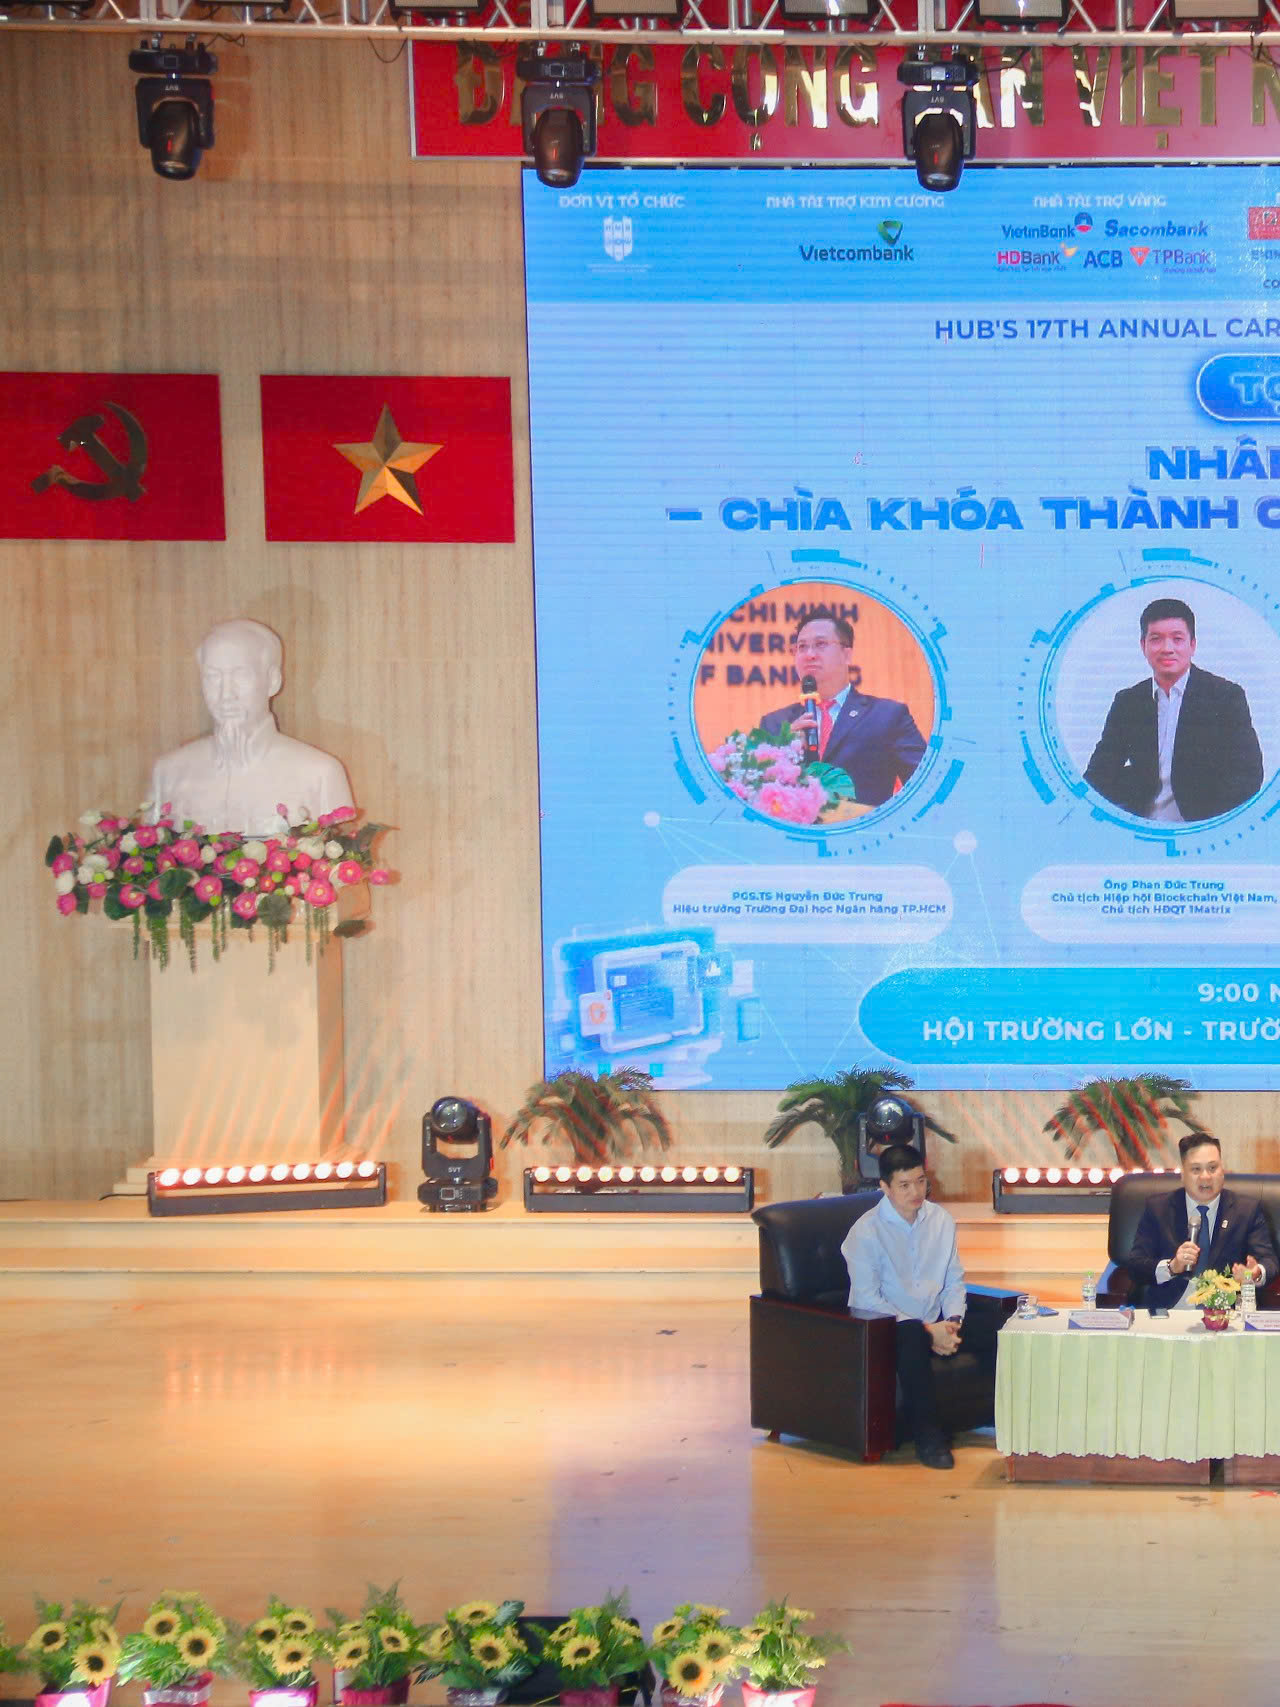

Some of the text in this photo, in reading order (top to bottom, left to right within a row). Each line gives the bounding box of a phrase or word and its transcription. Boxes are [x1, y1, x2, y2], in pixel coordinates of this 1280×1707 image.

[1001, 224, 1076, 239] VietinBank
[1104, 219, 1208, 237] Sacombank
[799, 245, 914, 261] Vietcombank
[997, 250, 1060, 265] HDBank
[1083, 250, 1123, 269] ACB
[1152, 249, 1211, 265] TPBank
[935, 319, 1018, 339] HUB'S
[1027, 319, 1089, 339] 17TH
[1099, 318, 1217, 338] ANNUAL
[719, 486, 852, 531] CHÌA
[866, 486, 1024, 531] KHÓA
[1039, 485, 1239, 530] THÀNH
[1132, 880, 1161, 890] Phan
[1190, 880, 1225, 891] Trung
[732, 891, 772, 901] PGS.TS
[849, 891, 883, 903] Trung
[1154, 893, 1219, 902] Blockchain
[902, 904, 946, 914] TP.HCM
[1198, 983, 1260, 1003] 9:00
[923, 1016, 975, 1046] HỘI
[984, 1016, 1104, 1042] TRƯỜNG
[1115, 1016, 1174, 1042] LỚN
